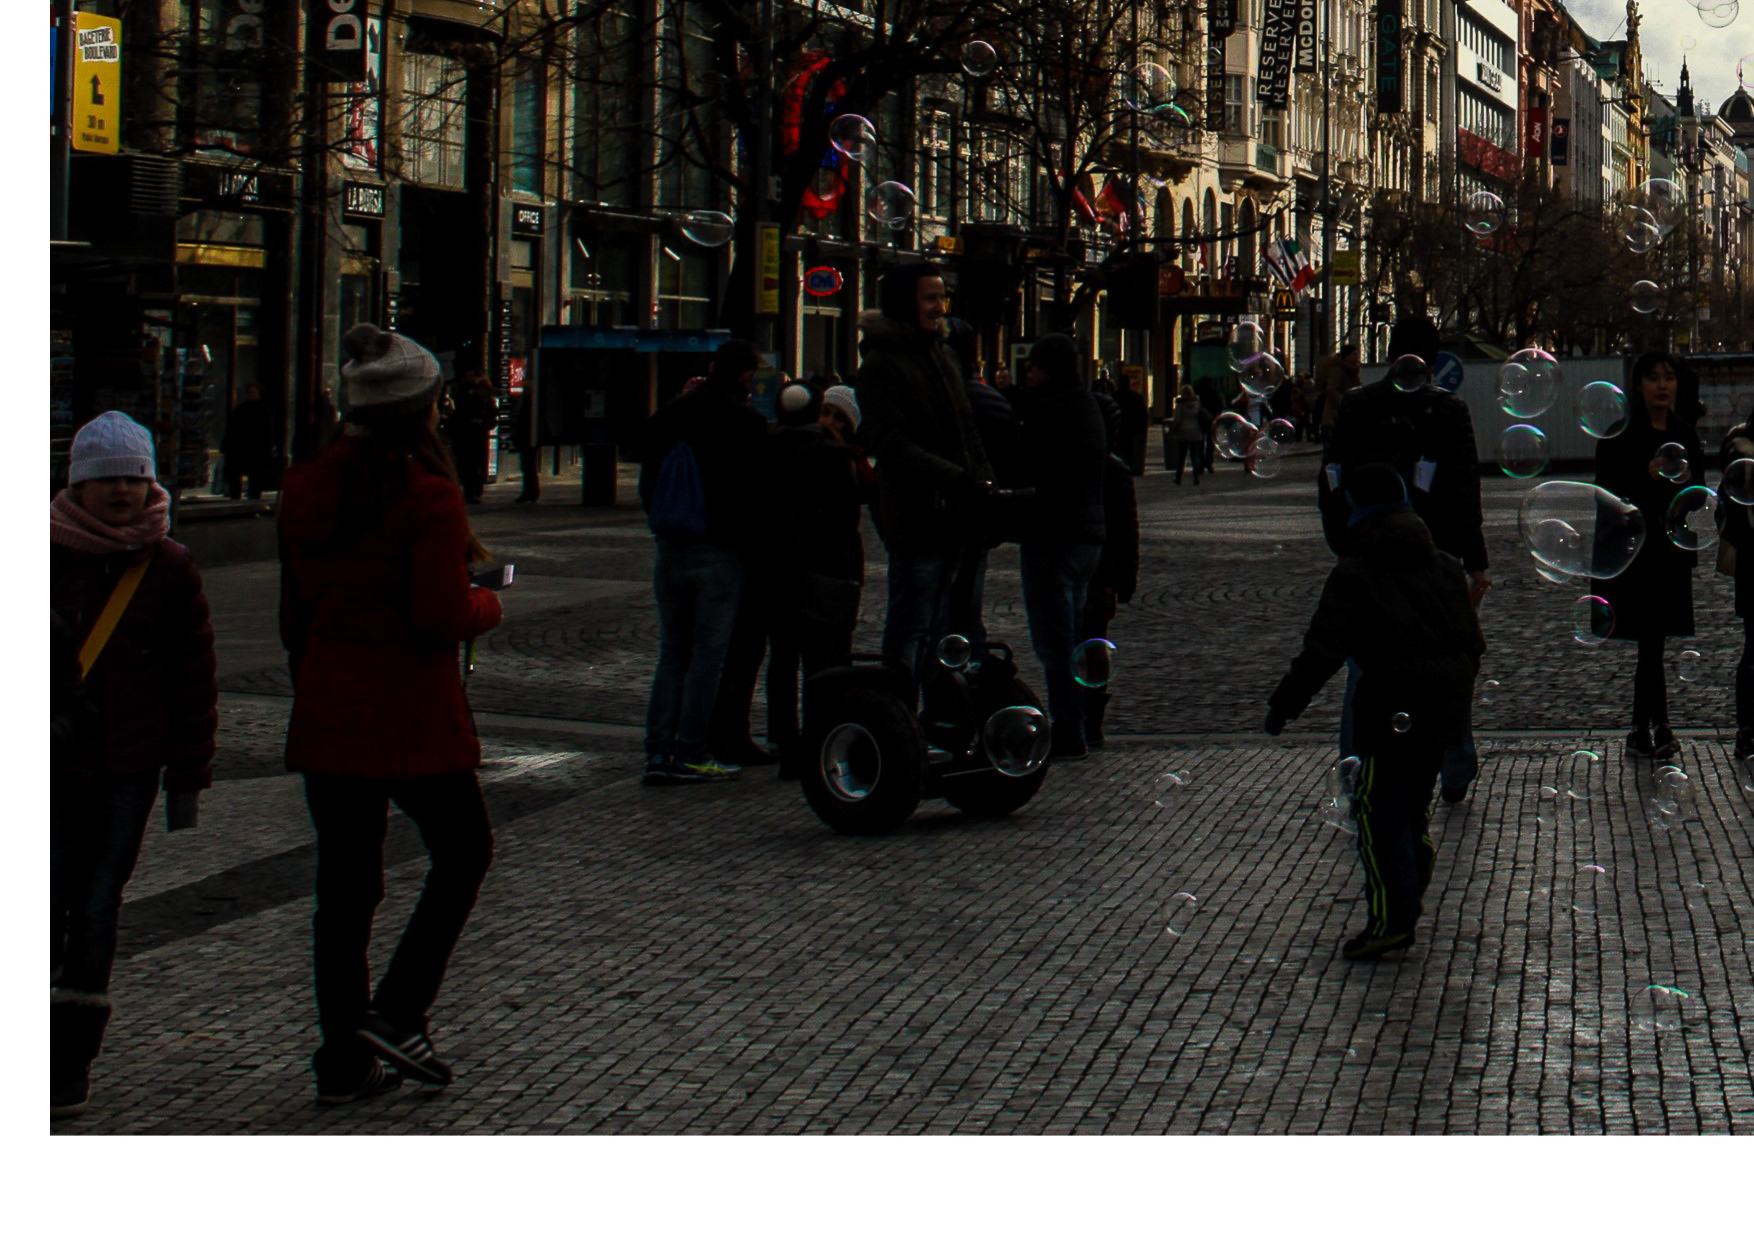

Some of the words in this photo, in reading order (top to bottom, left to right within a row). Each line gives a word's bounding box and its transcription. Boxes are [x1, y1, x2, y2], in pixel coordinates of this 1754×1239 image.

[84, 45, 118, 59] BOULEVARD
[1380, 13, 1398, 93] GATE
[1208, 31, 1223, 130] RESERVE
[518, 209, 540, 225] OFFICE
